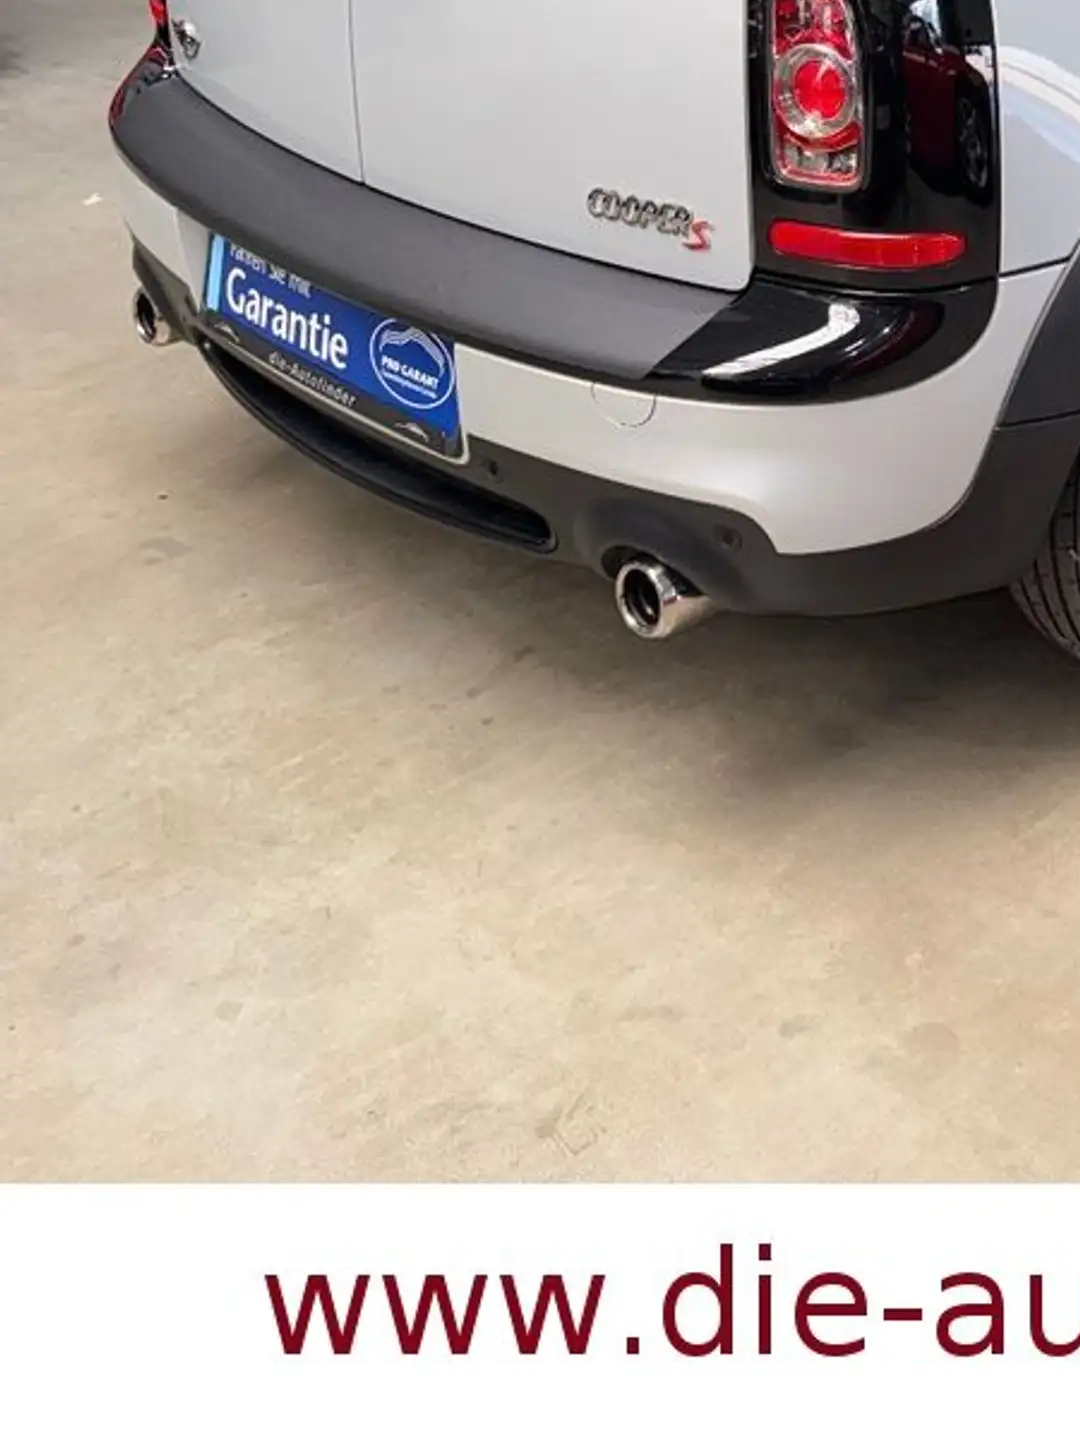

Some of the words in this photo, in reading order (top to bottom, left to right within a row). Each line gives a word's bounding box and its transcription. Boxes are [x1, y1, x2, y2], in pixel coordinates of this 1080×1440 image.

[587, 187, 692, 238] COOPER
[682, 220, 714, 251] S
[226, 266, 349, 370] Garantie
